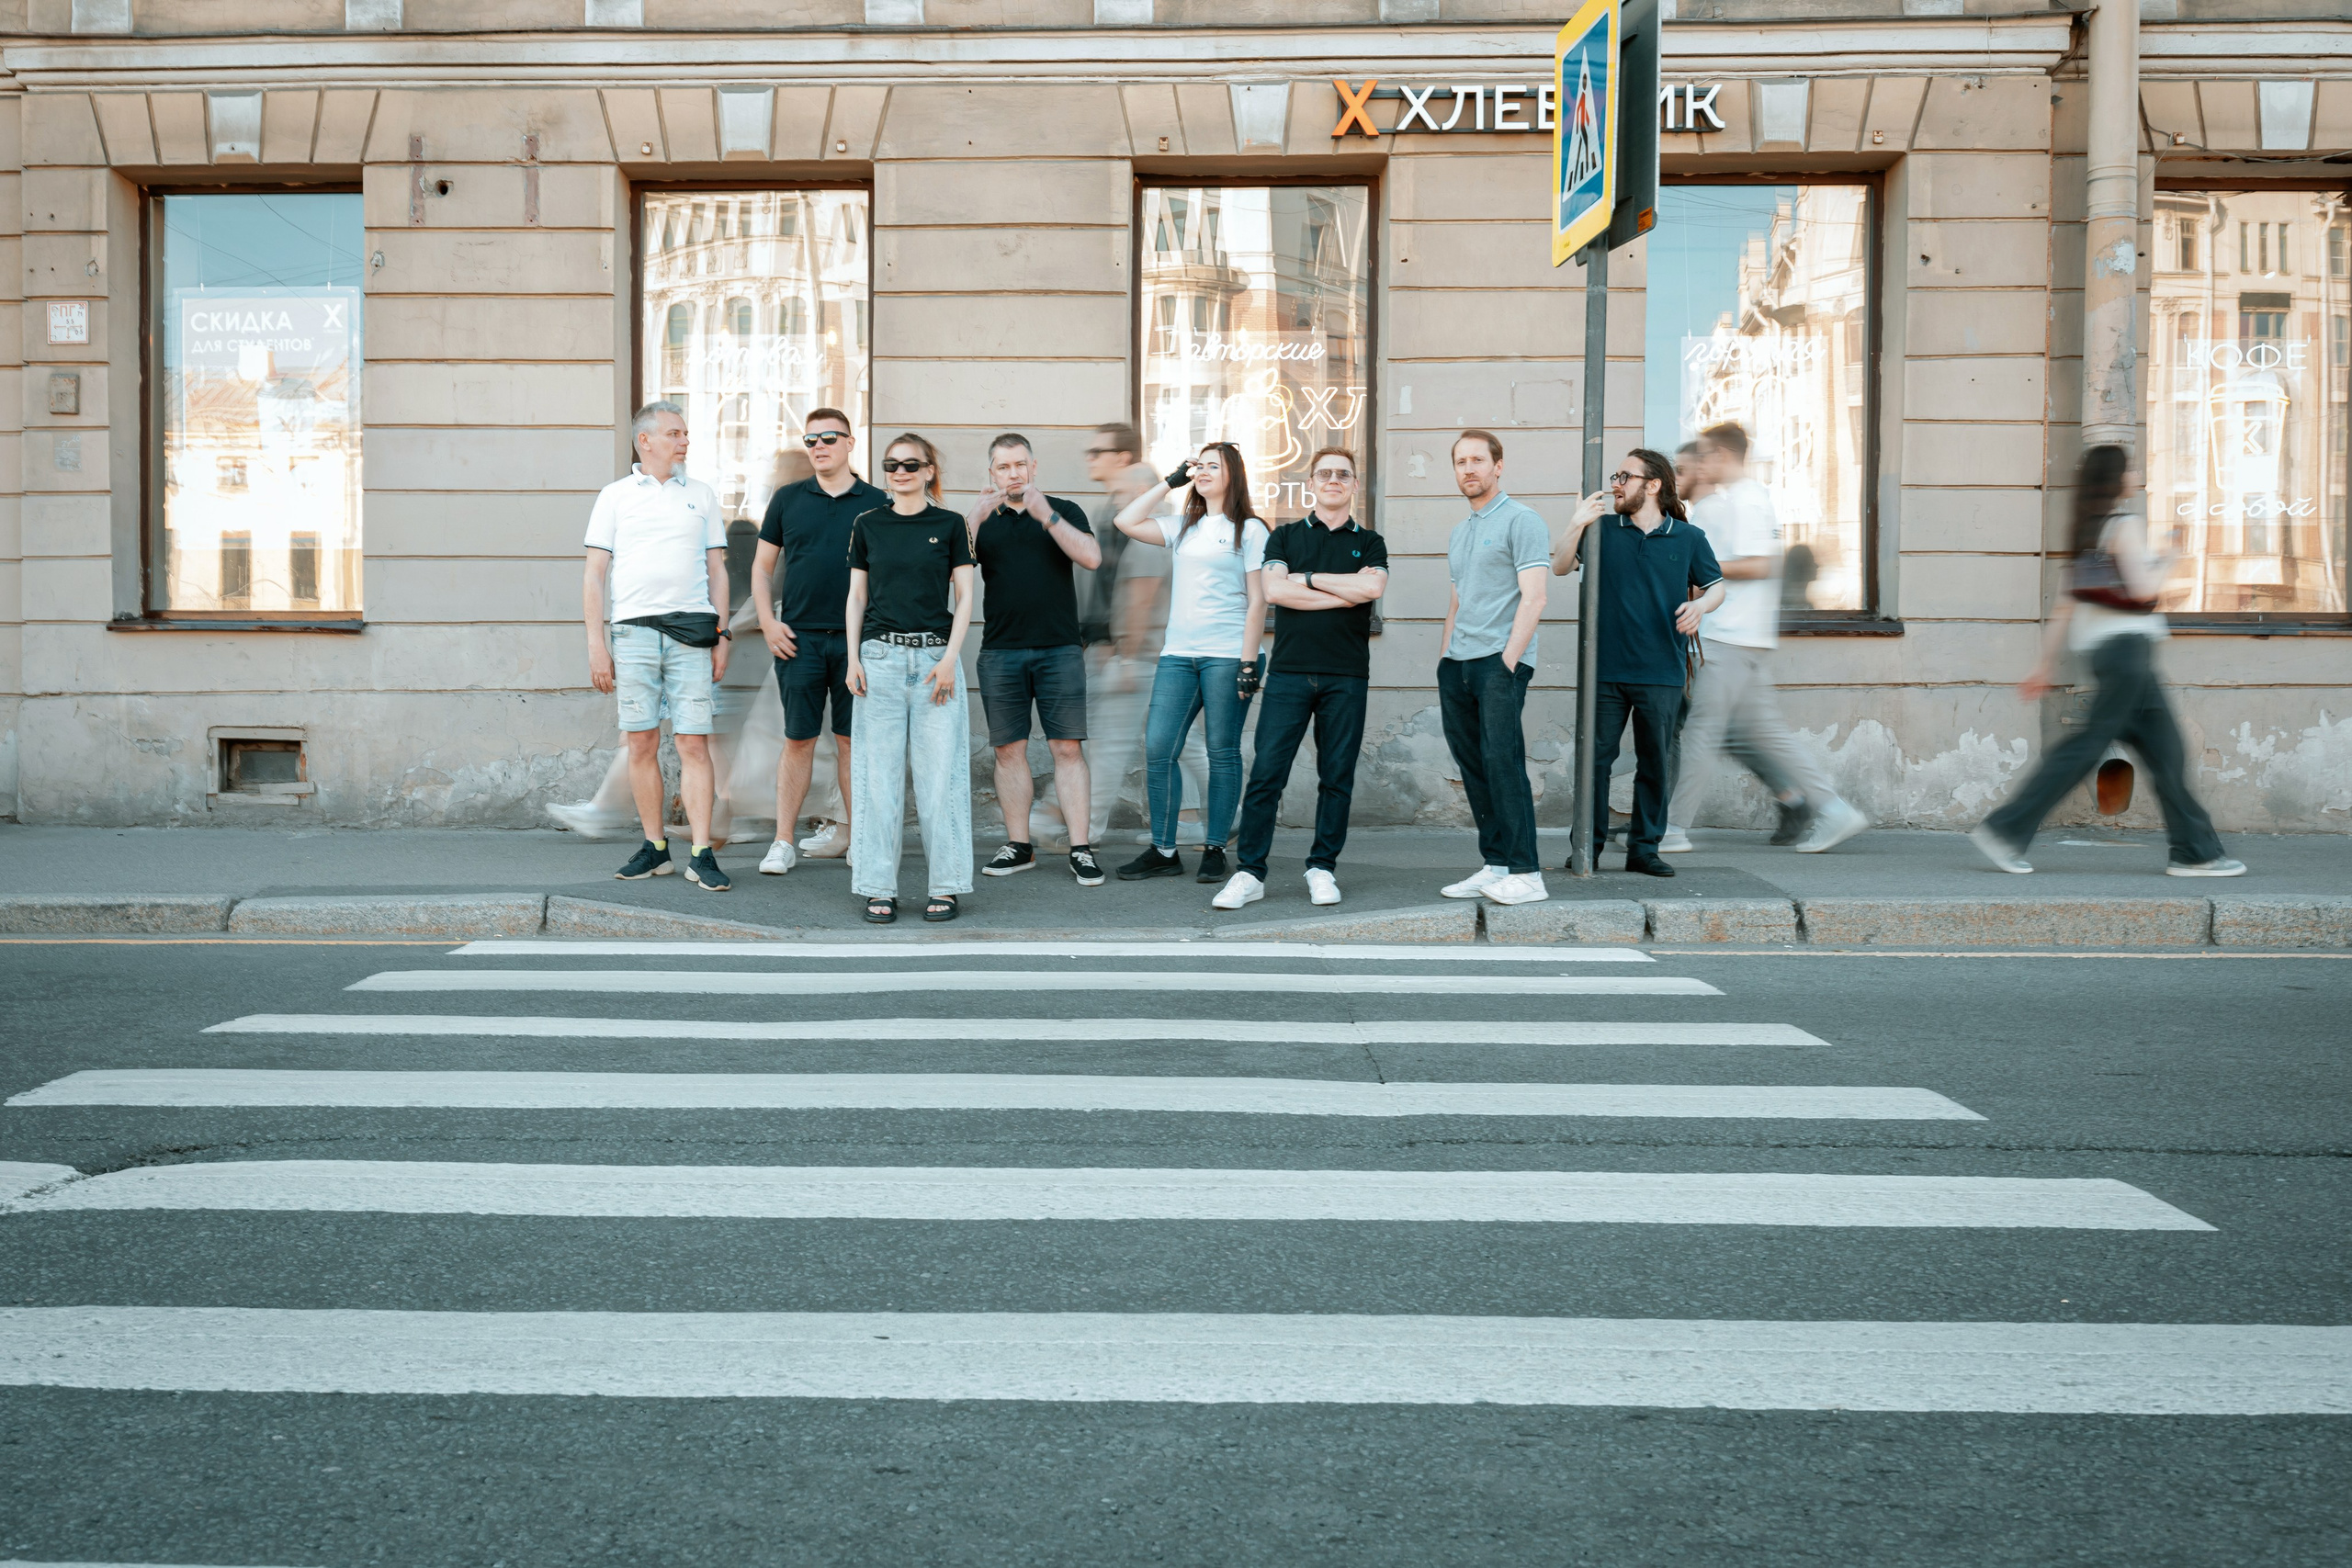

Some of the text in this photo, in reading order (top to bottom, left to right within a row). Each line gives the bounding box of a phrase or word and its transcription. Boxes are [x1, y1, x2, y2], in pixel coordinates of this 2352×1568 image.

[60, 305, 75, 317] ПГ
[191, 311, 293, 333] СКИДКА
[191, 340, 222, 354] ДЛЯ
[1189, 333, 1326, 367] авторские
[2186, 343, 2309, 371] КОФЕ
[2209, 497, 2316, 516] сбой
